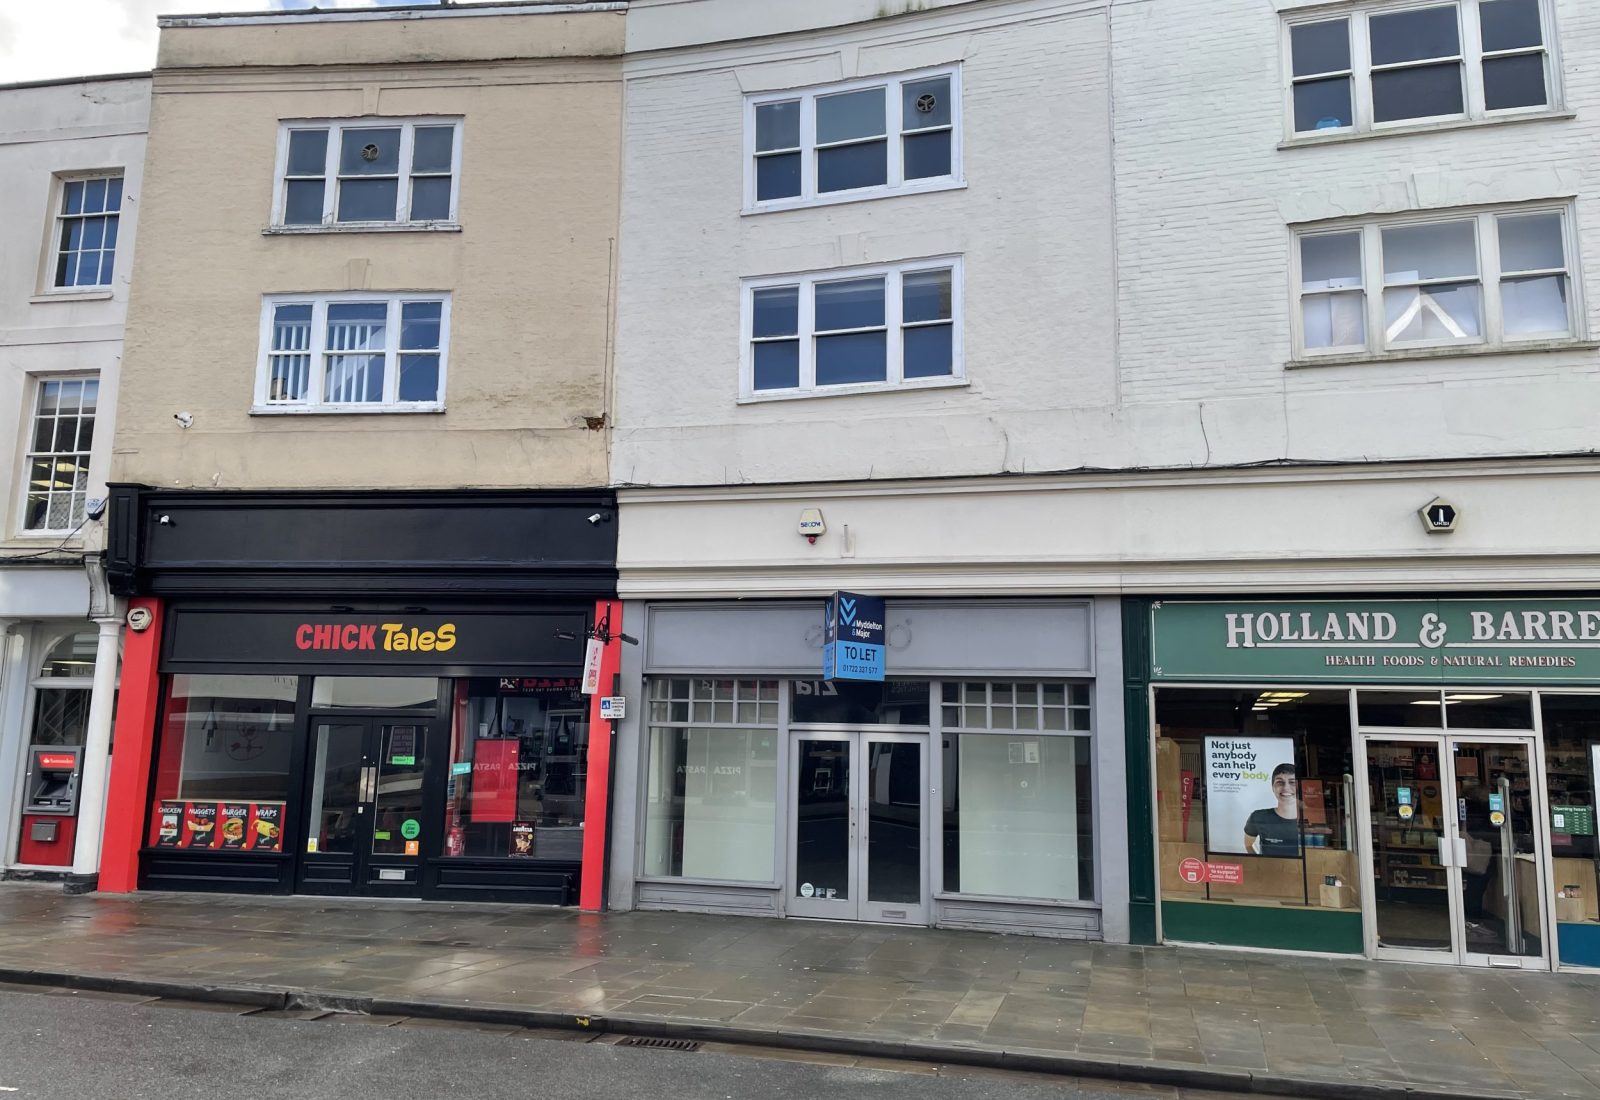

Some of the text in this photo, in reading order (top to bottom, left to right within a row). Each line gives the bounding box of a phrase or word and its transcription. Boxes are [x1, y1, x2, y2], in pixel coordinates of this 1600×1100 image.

[856, 620, 883, 631] Myddelton
[1225, 611, 1600, 648] HOLLAND & BARRE
[295, 623, 377, 650] CHICK
[856, 628, 871, 639] Major
[844, 646, 877, 662] TO LET
[1325, 656, 1576, 667] HEALTH FOODS & NATURAL REMEDIES
[842, 664, 858, 673] 01722
[868, 666, 878, 675] 577
[1212, 740, 1251, 751] Not just
[1212, 751, 1257, 761] anybody
[1233, 761, 1256, 771] help
[1212, 772, 1241, 780] every
[222, 808, 247, 816] BURGER
